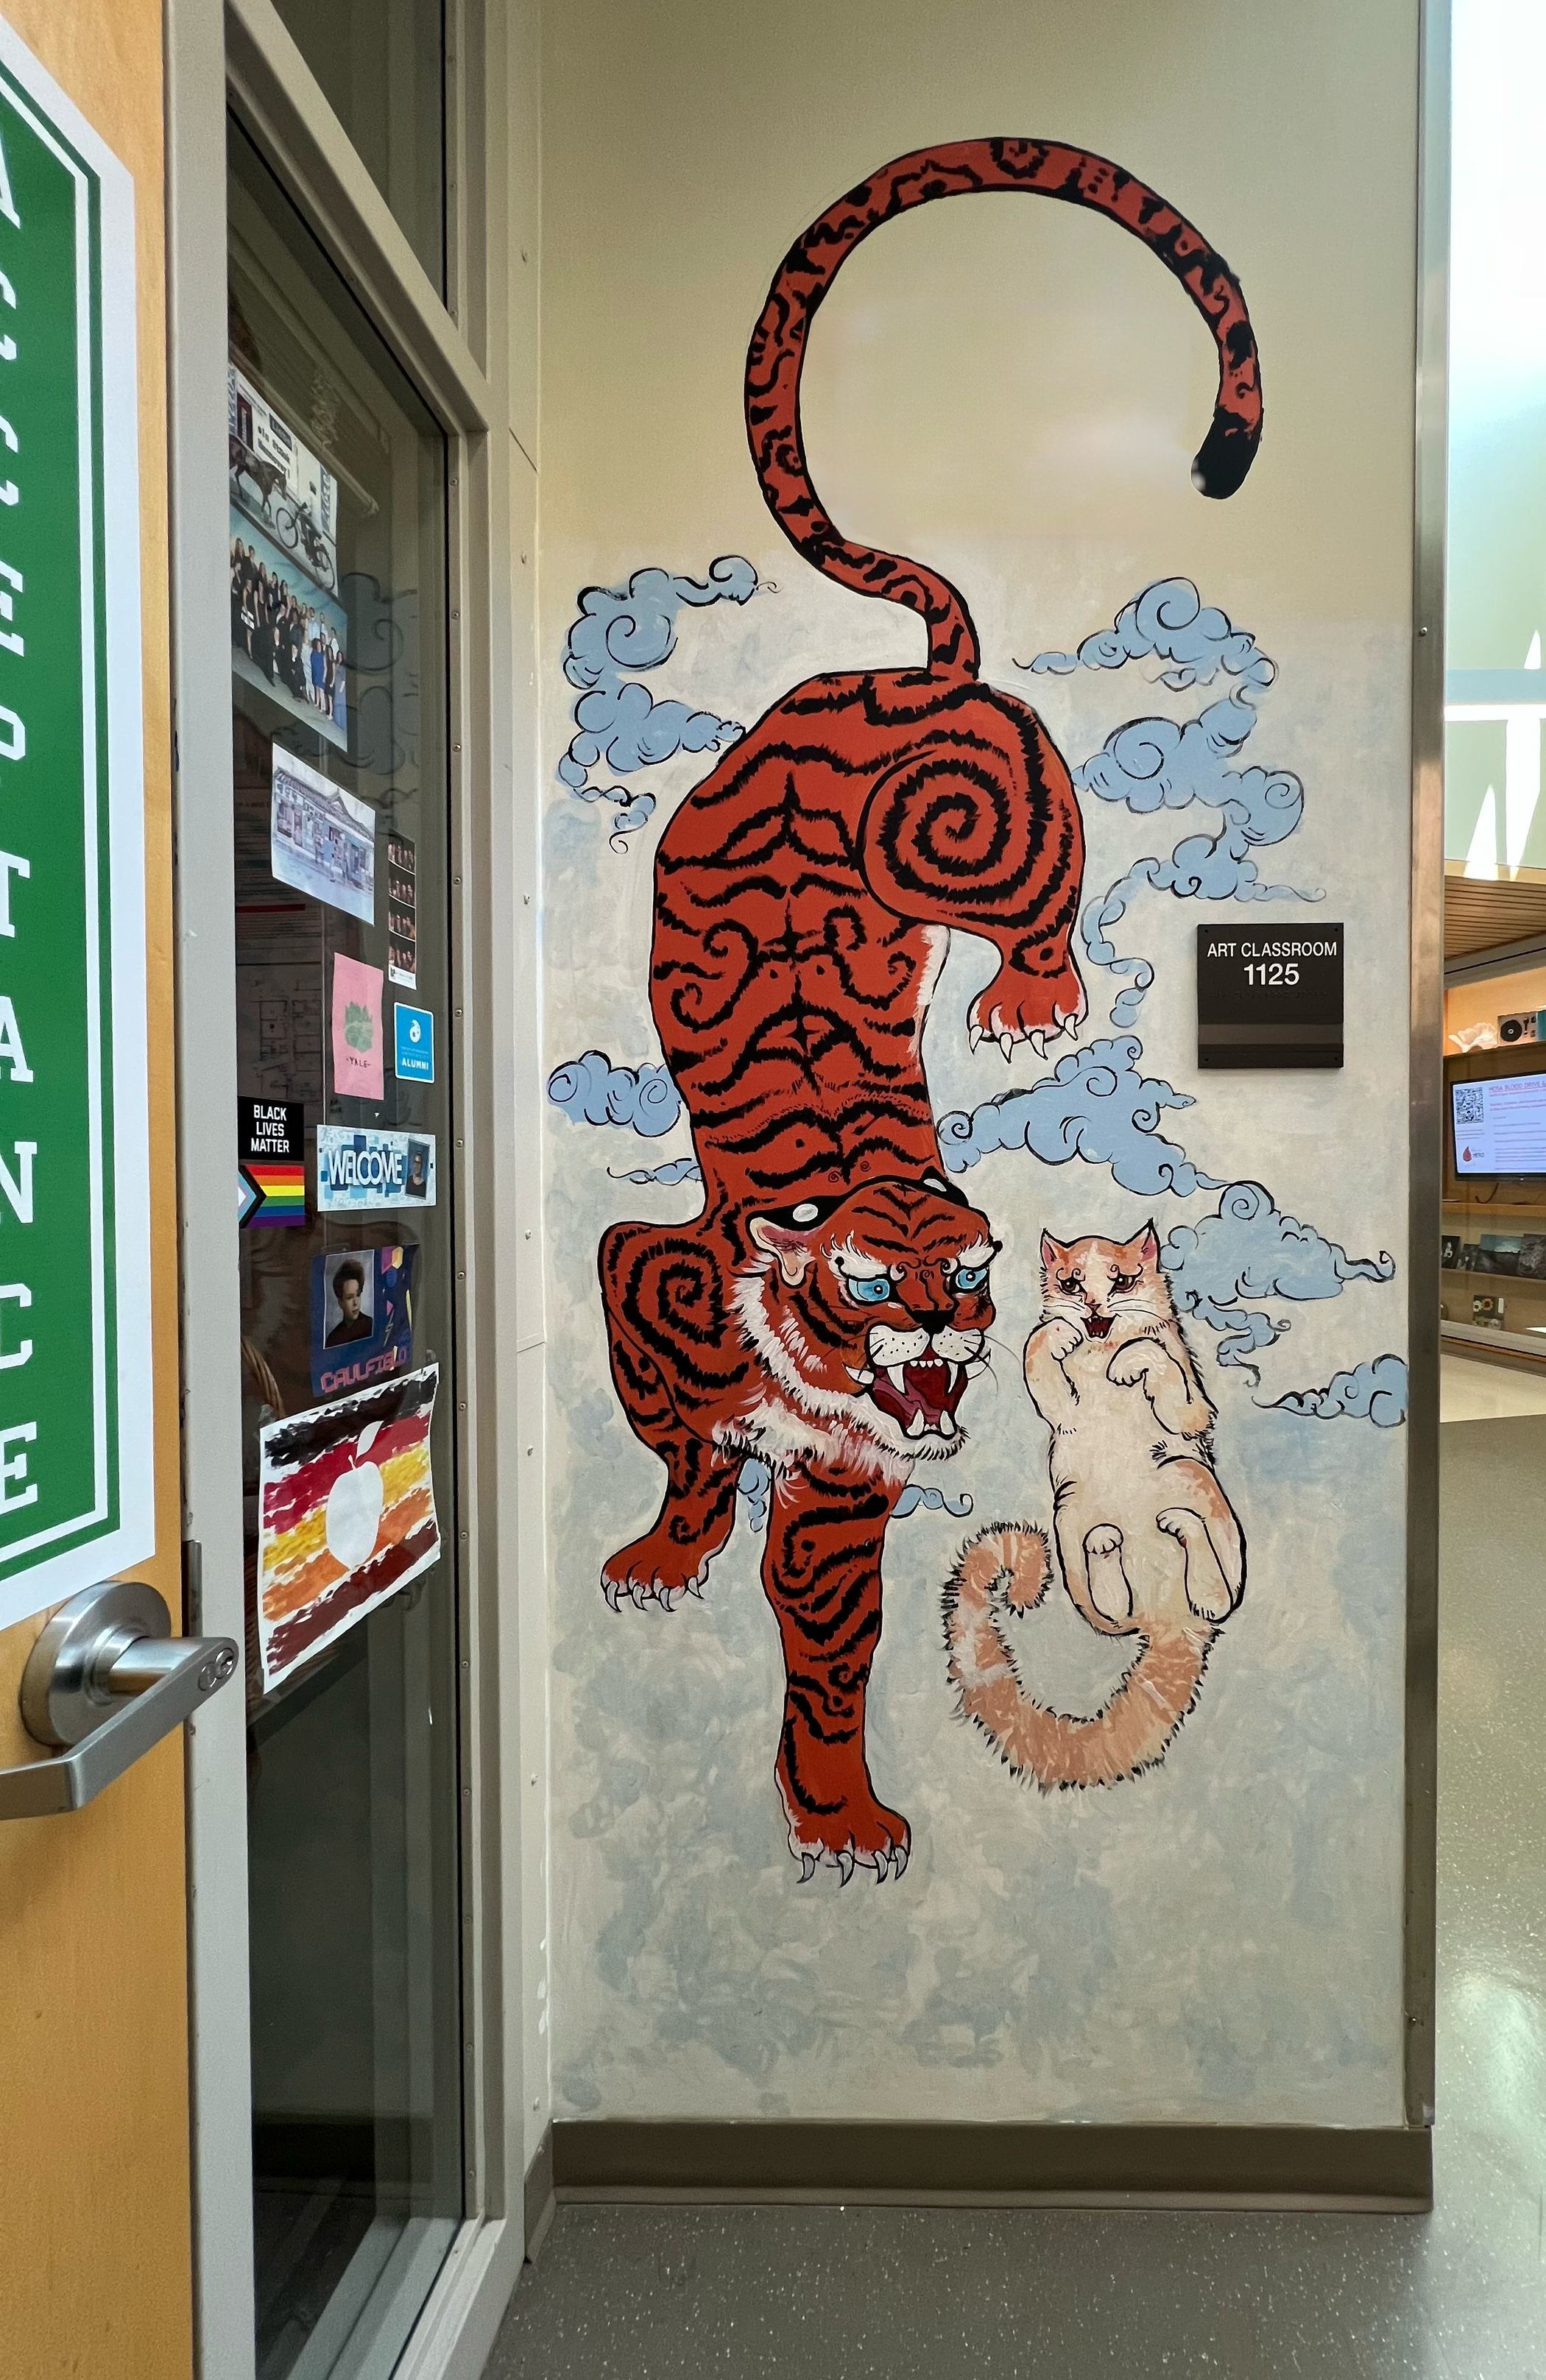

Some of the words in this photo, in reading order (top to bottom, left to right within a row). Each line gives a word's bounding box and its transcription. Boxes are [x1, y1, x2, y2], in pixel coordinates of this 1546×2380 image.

[0, 130, 38, 1514] TANCE
[1207, 943, 1237, 957] ART
[1241, 942, 1337, 957] CLASSROOM
[1243, 963, 1299, 985] 1125
[401, 1057, 429, 1070] ALUMNI
[253, 1104, 287, 1121] BLACK
[256, 1121, 285, 1137] LIVES
[251, 1137, 289, 1153] MATTER
[328, 1150, 402, 1186] WELCOME
